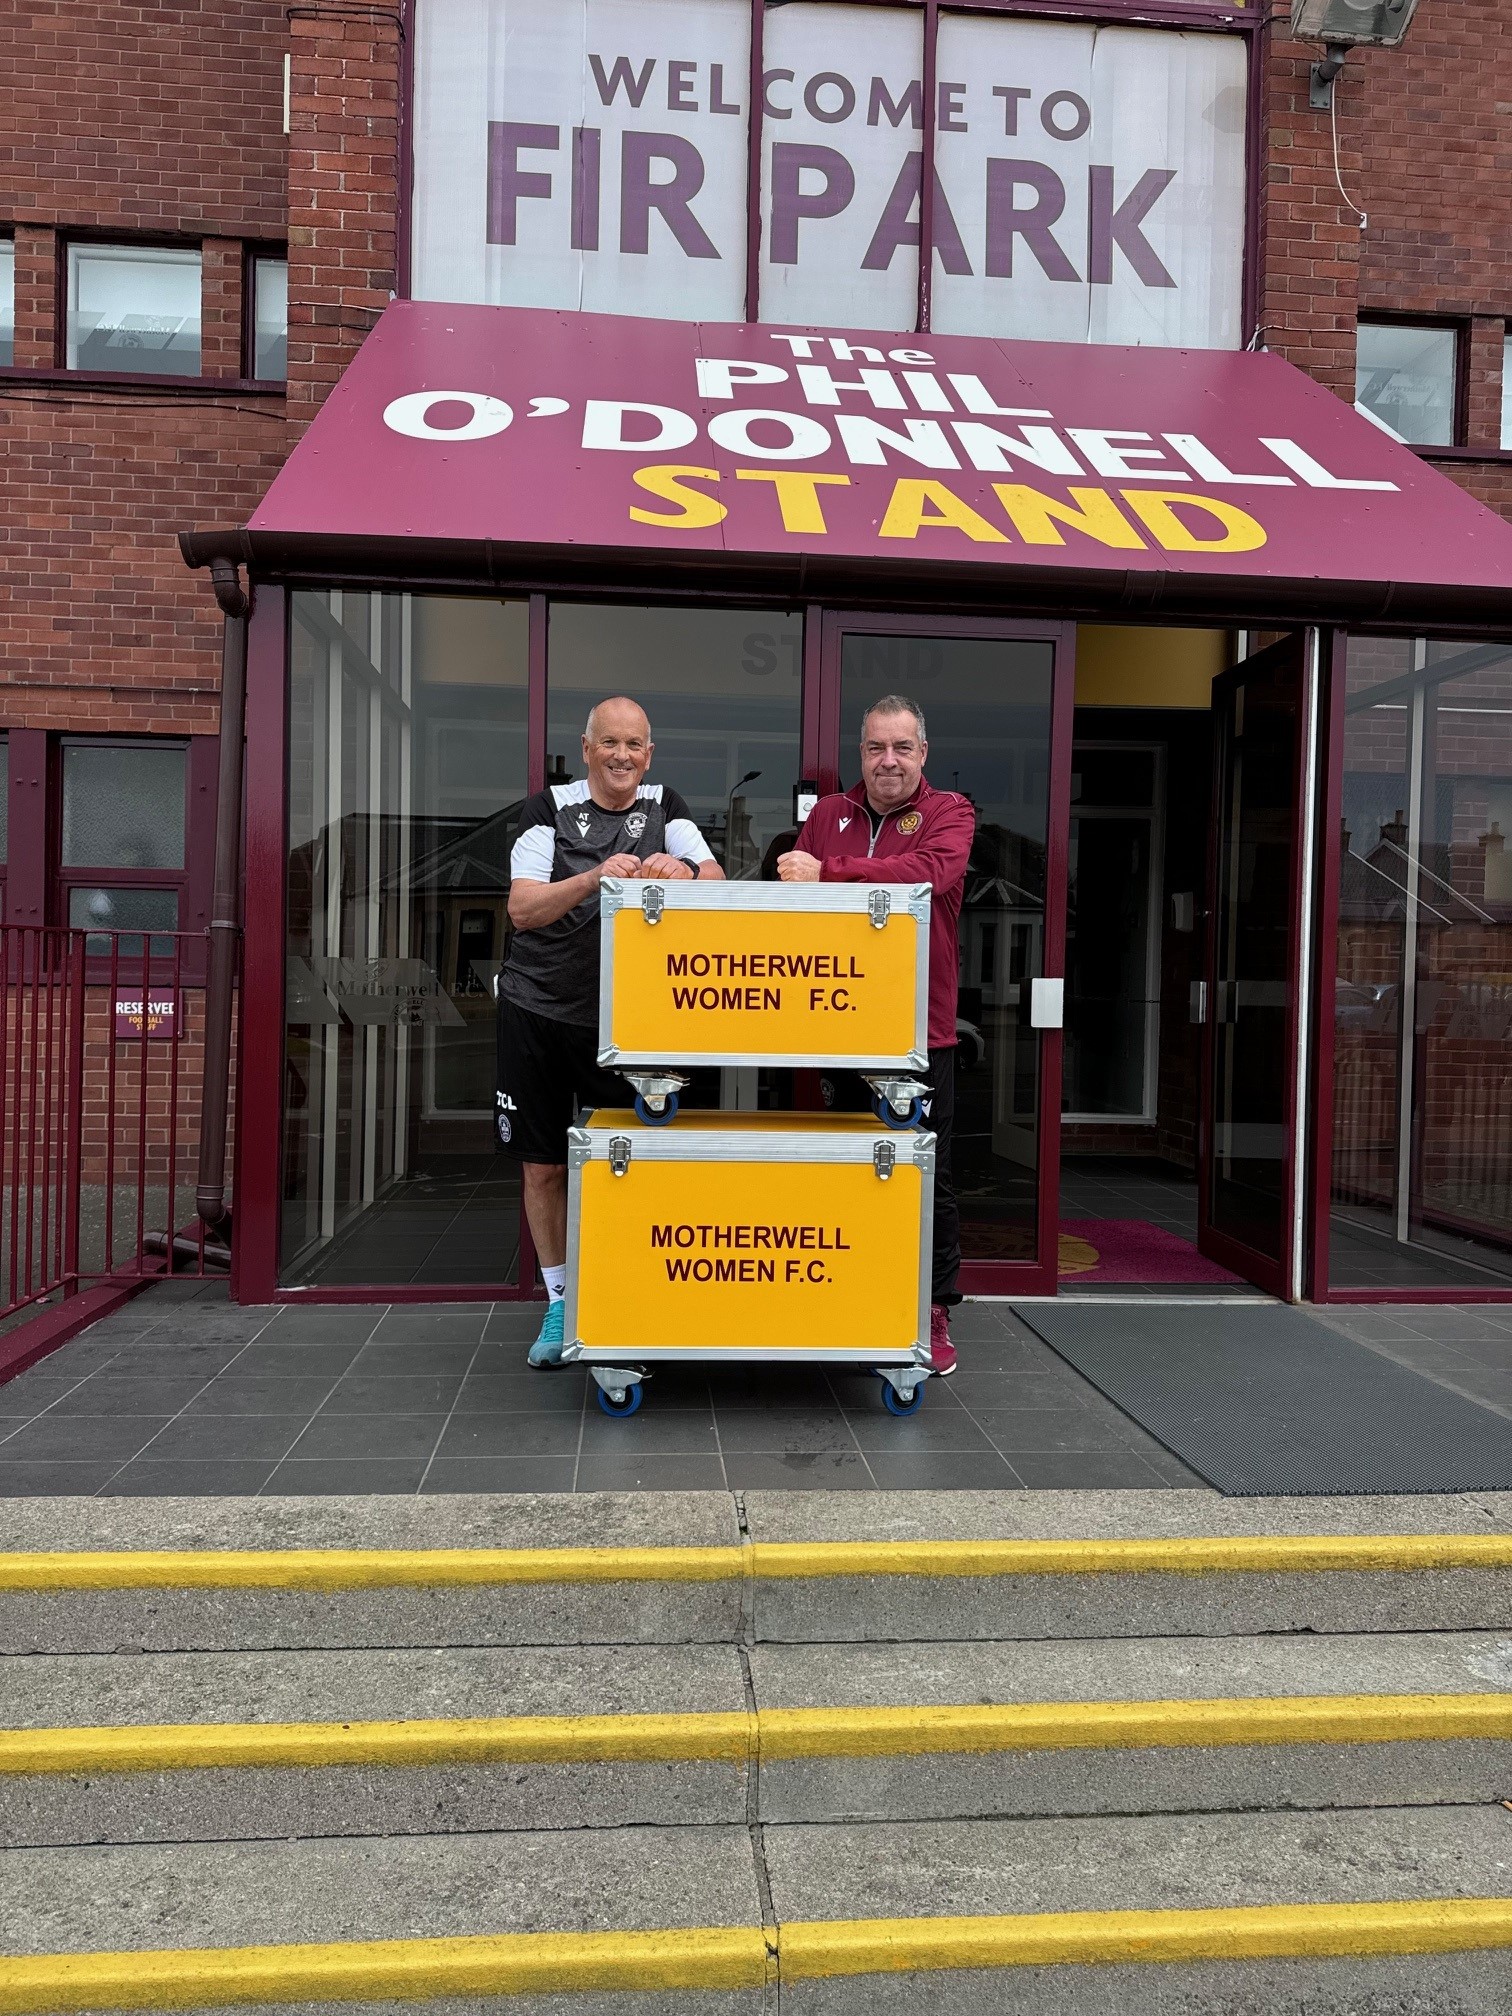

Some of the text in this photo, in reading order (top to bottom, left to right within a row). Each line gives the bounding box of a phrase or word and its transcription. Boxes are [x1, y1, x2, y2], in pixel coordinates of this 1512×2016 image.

[587, 53, 1091, 142] WELCOME TO
[485, 119, 1178, 289] FIR PARK
[770, 334, 936, 366] The
[695, 356, 1053, 418] PHIL
[629, 464, 1269, 553] STAND
[578, 812, 590, 821] AT
[666, 954, 865, 978] MOTHERWELL
[672, 987, 857, 1011] WOMEN F.C.
[496, 1090, 518, 1110] TCL
[651, 1225, 850, 1249] MOTHERWELL
[665, 1259, 833, 1283] WOMEN F.C.
